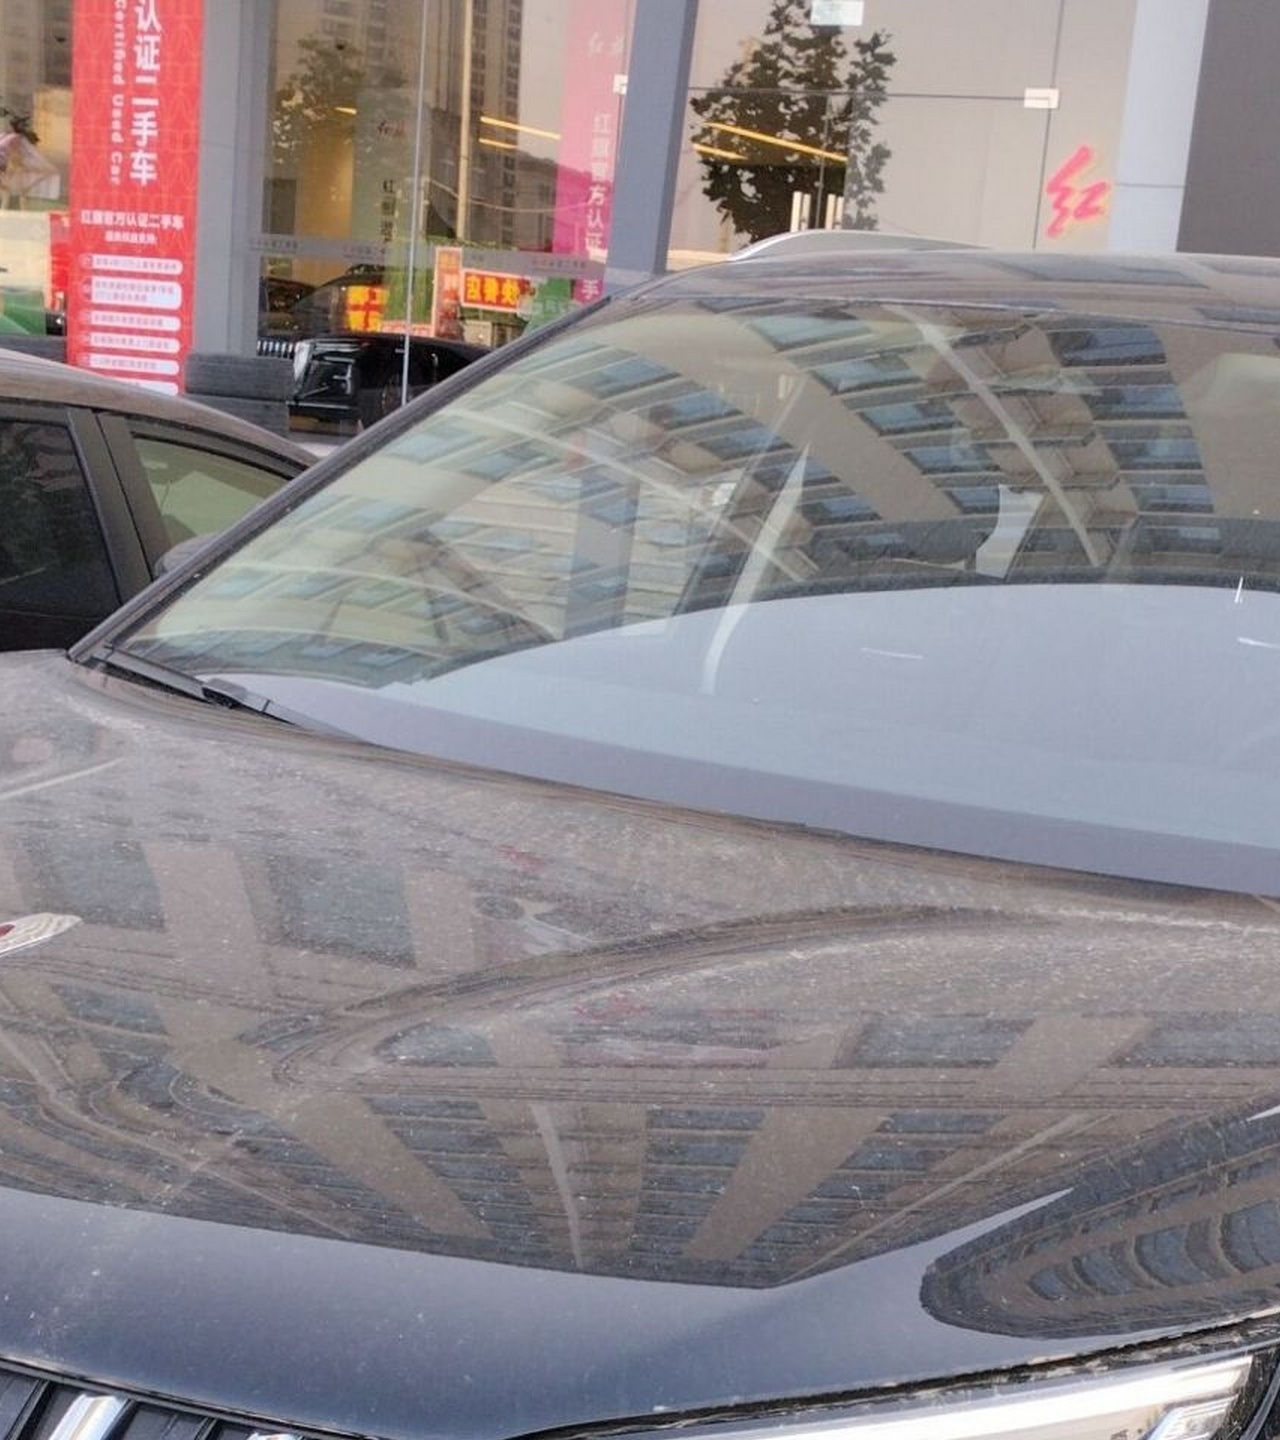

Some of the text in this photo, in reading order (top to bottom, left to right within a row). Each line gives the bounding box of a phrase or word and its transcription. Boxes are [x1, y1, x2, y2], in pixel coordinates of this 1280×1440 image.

[129, 0, 163, 187] 认证二手车
